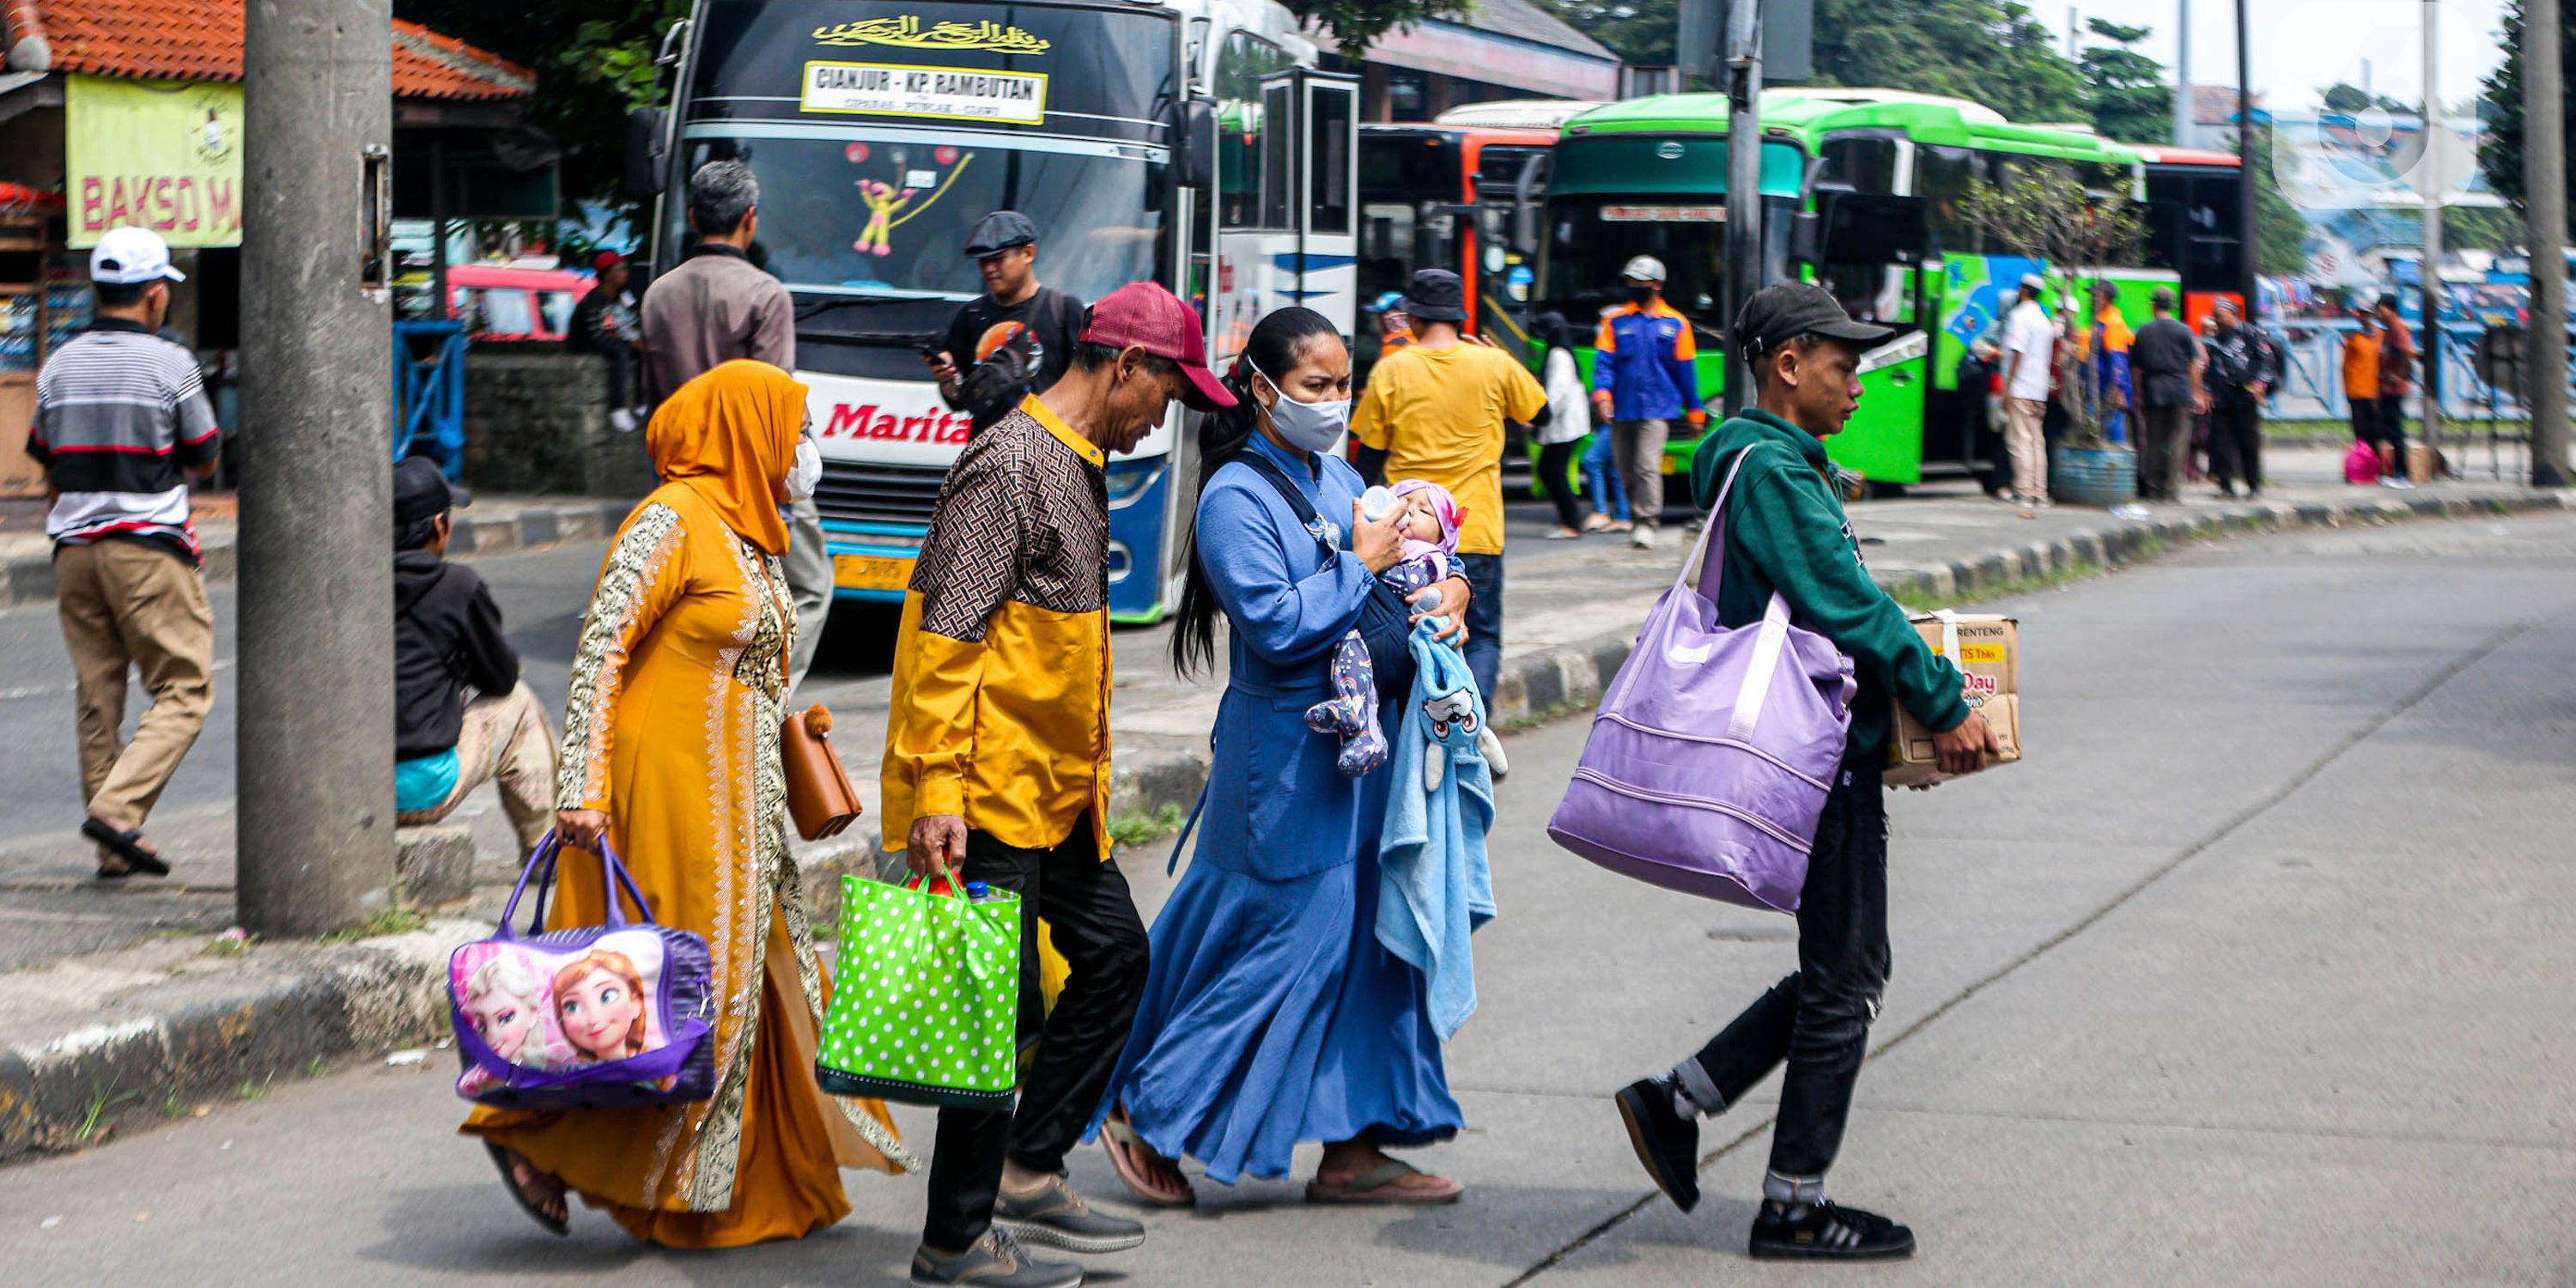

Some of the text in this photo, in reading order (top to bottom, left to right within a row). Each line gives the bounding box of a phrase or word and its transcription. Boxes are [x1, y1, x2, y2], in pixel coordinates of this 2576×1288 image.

[817, 69, 890, 91] CIANJUR
[905, 72, 930, 94] KP.
[934, 74, 1034, 100] RAMBUTAN
[83, 177, 200, 232] BAKSO
[823, 404, 973, 445] Marita
[1958, 627, 2004, 637] RENTENG
[1963, 672, 1995, 695] Day
